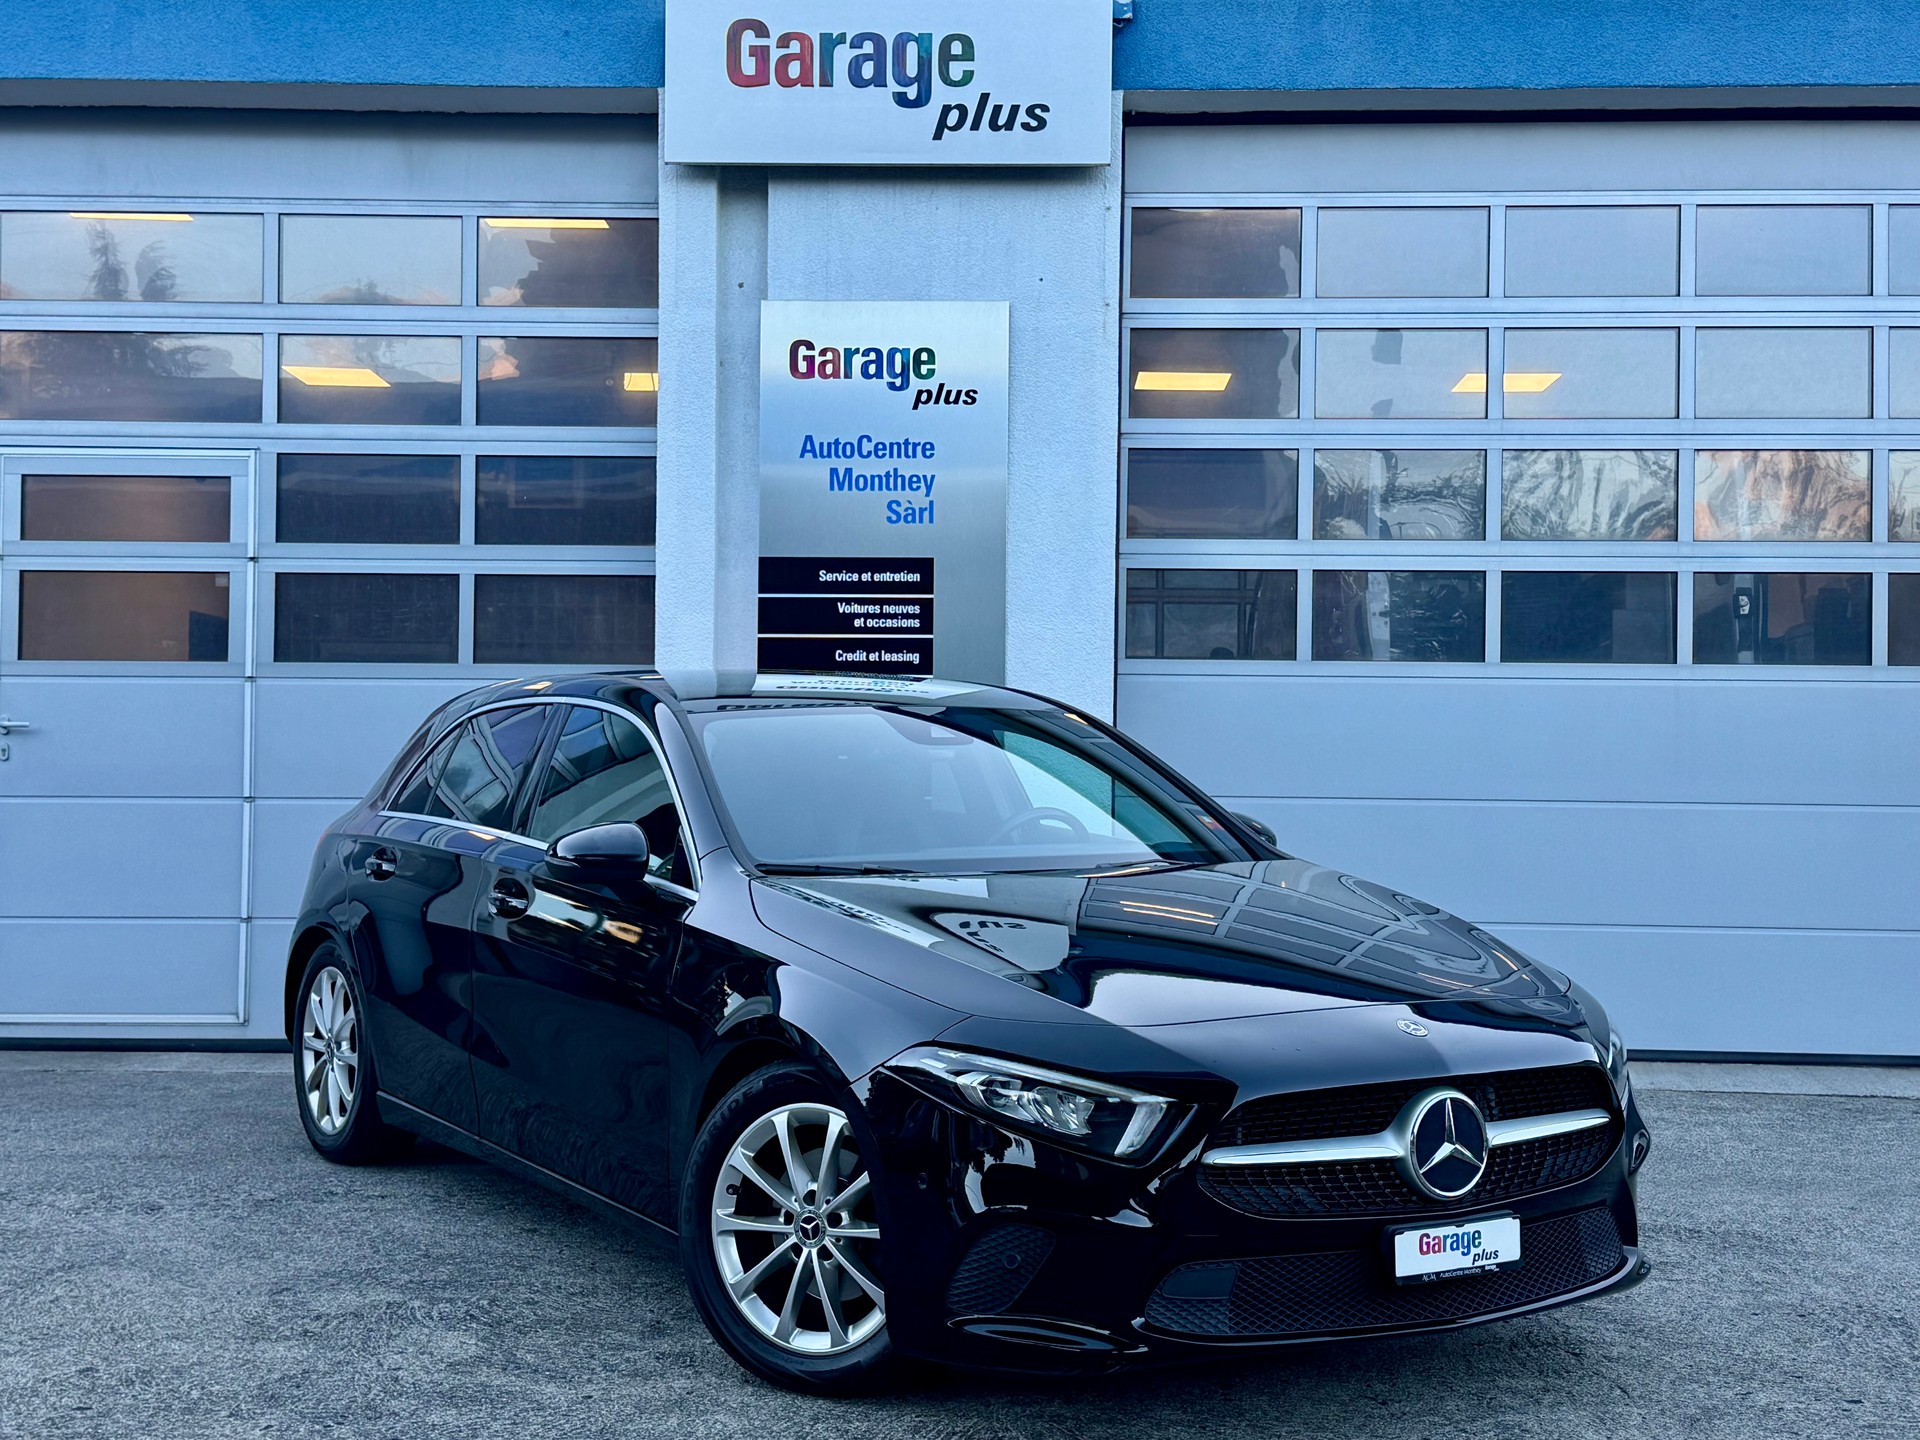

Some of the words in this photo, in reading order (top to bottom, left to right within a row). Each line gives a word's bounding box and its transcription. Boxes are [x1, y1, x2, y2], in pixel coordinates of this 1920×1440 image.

[726, 18, 975, 109] Garage
[932, 92, 1050, 141] plus
[789, 339, 936, 392] Garage
[912, 383, 978, 410] plus
[799, 434, 936, 459] AutoCentre
[829, 467, 936, 497] Monthey
[886, 499, 935, 525] Sàrl
[818, 569, 859, 582] Service
[861, 570, 872, 582] et
[873, 570, 921, 582] entretien
[837, 602, 881, 614] Voitures
[882, 604, 921, 614] neuves
[853, 617, 865, 628] et
[866, 616, 921, 628] occasions
[835, 650, 867, 662] Credit
[868, 651, 880, 662] et
[881, 650, 920, 664] leasing
[1419, 1230, 1481, 1256] Garage
[1472, 1249, 1499, 1266] plus
